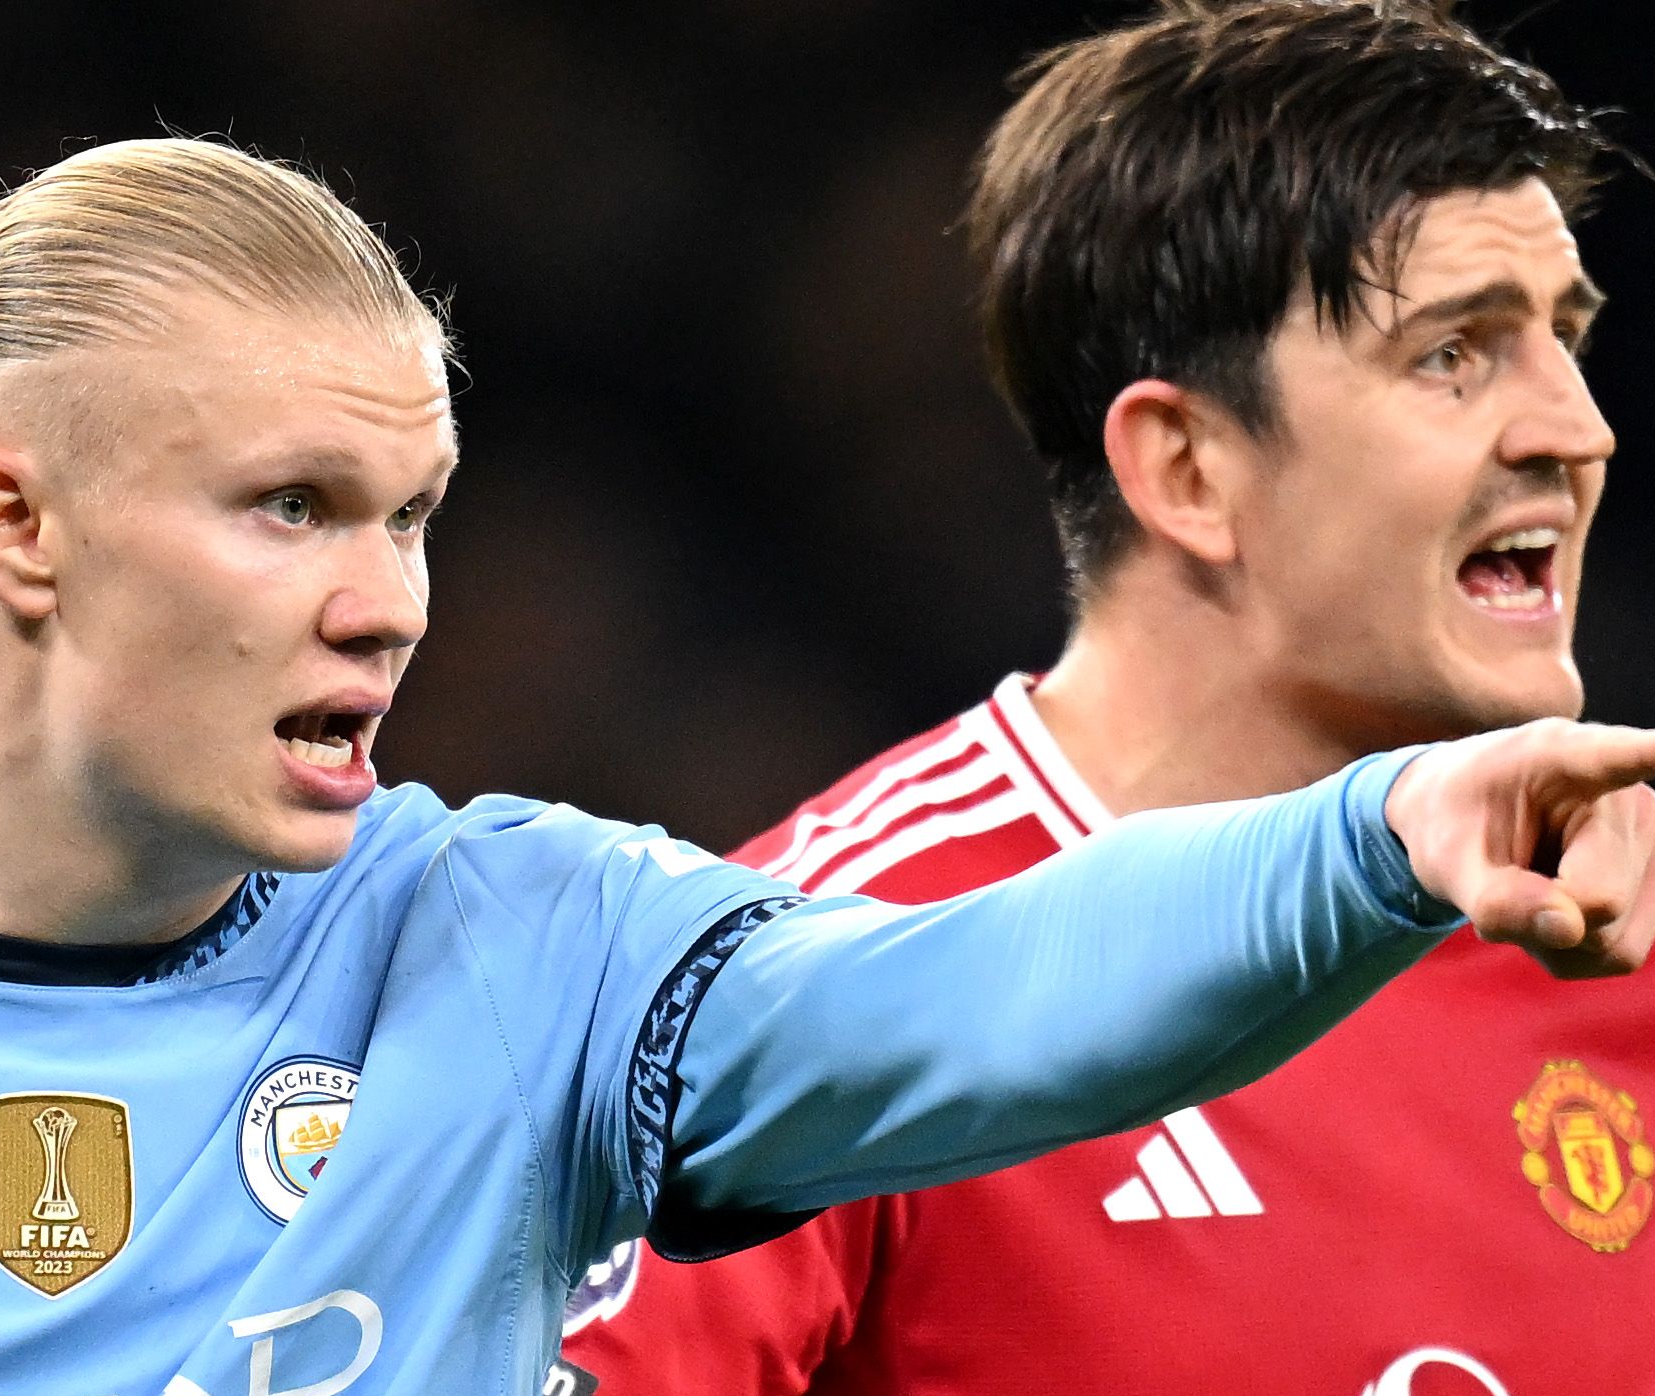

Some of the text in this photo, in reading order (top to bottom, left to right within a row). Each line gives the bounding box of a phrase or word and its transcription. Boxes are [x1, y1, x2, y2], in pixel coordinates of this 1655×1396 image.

[3, 1250, 105, 1259] WORLD CHAMPIONS
[34, 1261, 73, 1274] 2023
